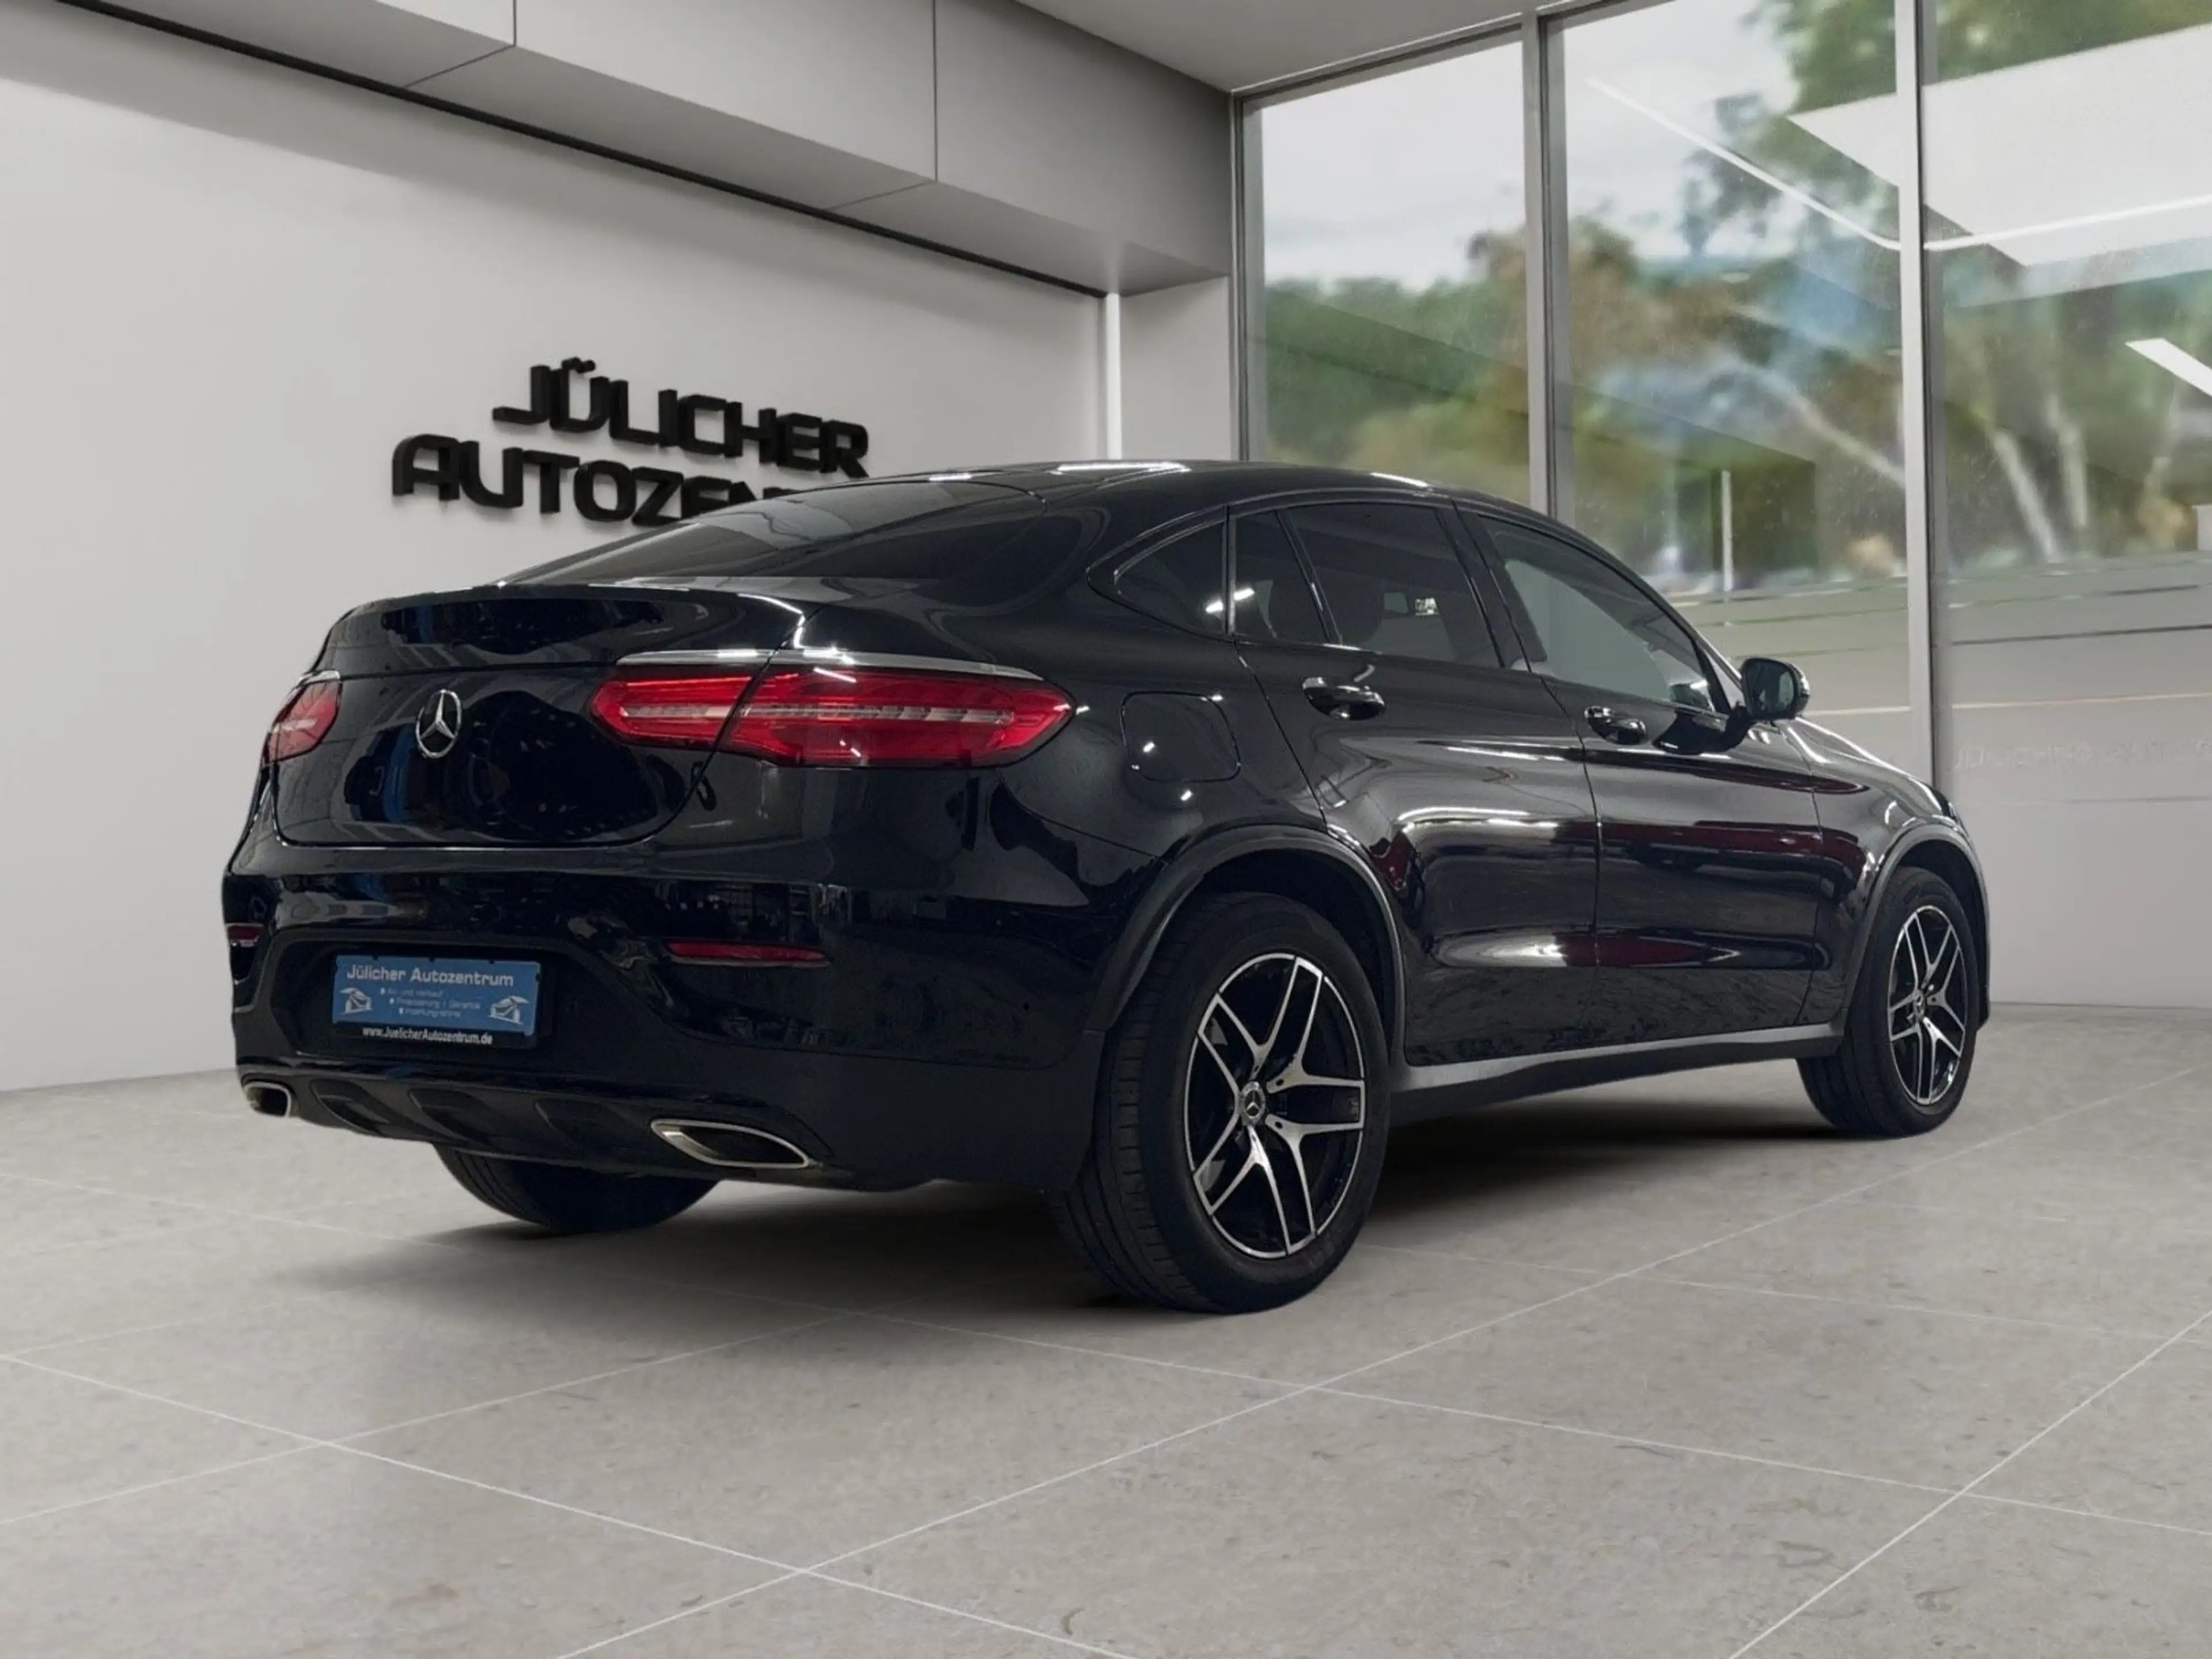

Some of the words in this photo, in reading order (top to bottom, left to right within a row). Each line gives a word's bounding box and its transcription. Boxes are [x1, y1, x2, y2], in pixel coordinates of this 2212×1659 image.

[493, 357, 869, 477] JÜLICHER
[347, 964, 406, 981] Jülicher
[410, 967, 514, 987] Autozentrum
[362, 1025, 493, 1046] www.JuelicherAutozentrum.de
